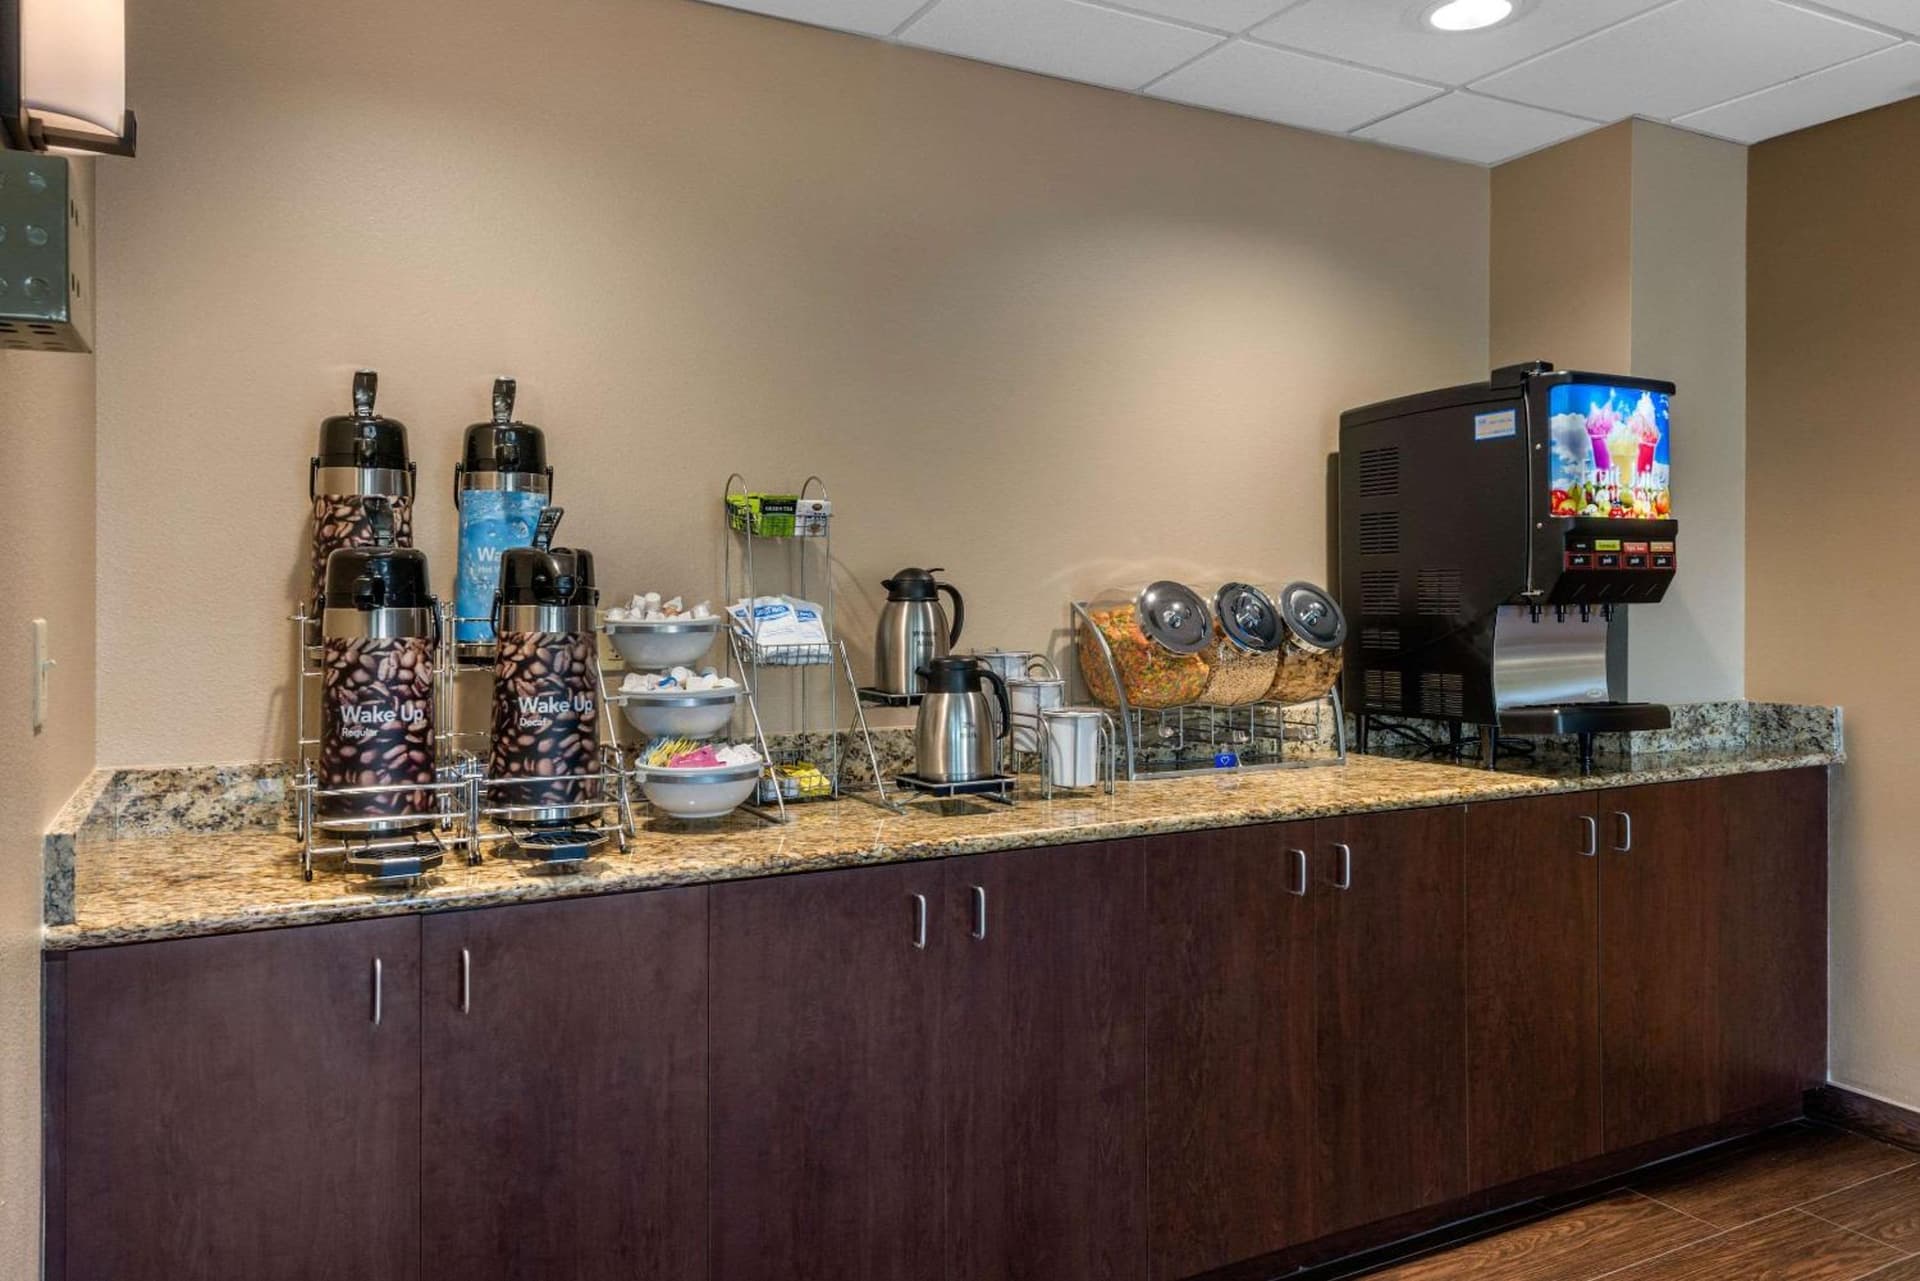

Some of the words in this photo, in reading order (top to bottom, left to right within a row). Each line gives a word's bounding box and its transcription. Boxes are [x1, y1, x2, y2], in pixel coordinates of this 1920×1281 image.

[477, 546, 502, 561] Wa
[518, 695, 571, 714] Wake
[573, 694, 594, 715] Up
[340, 704, 397, 723] Wake
[400, 703, 425, 725] Up
[519, 716, 548, 727] Decaf
[341, 727, 378, 739] Regular
